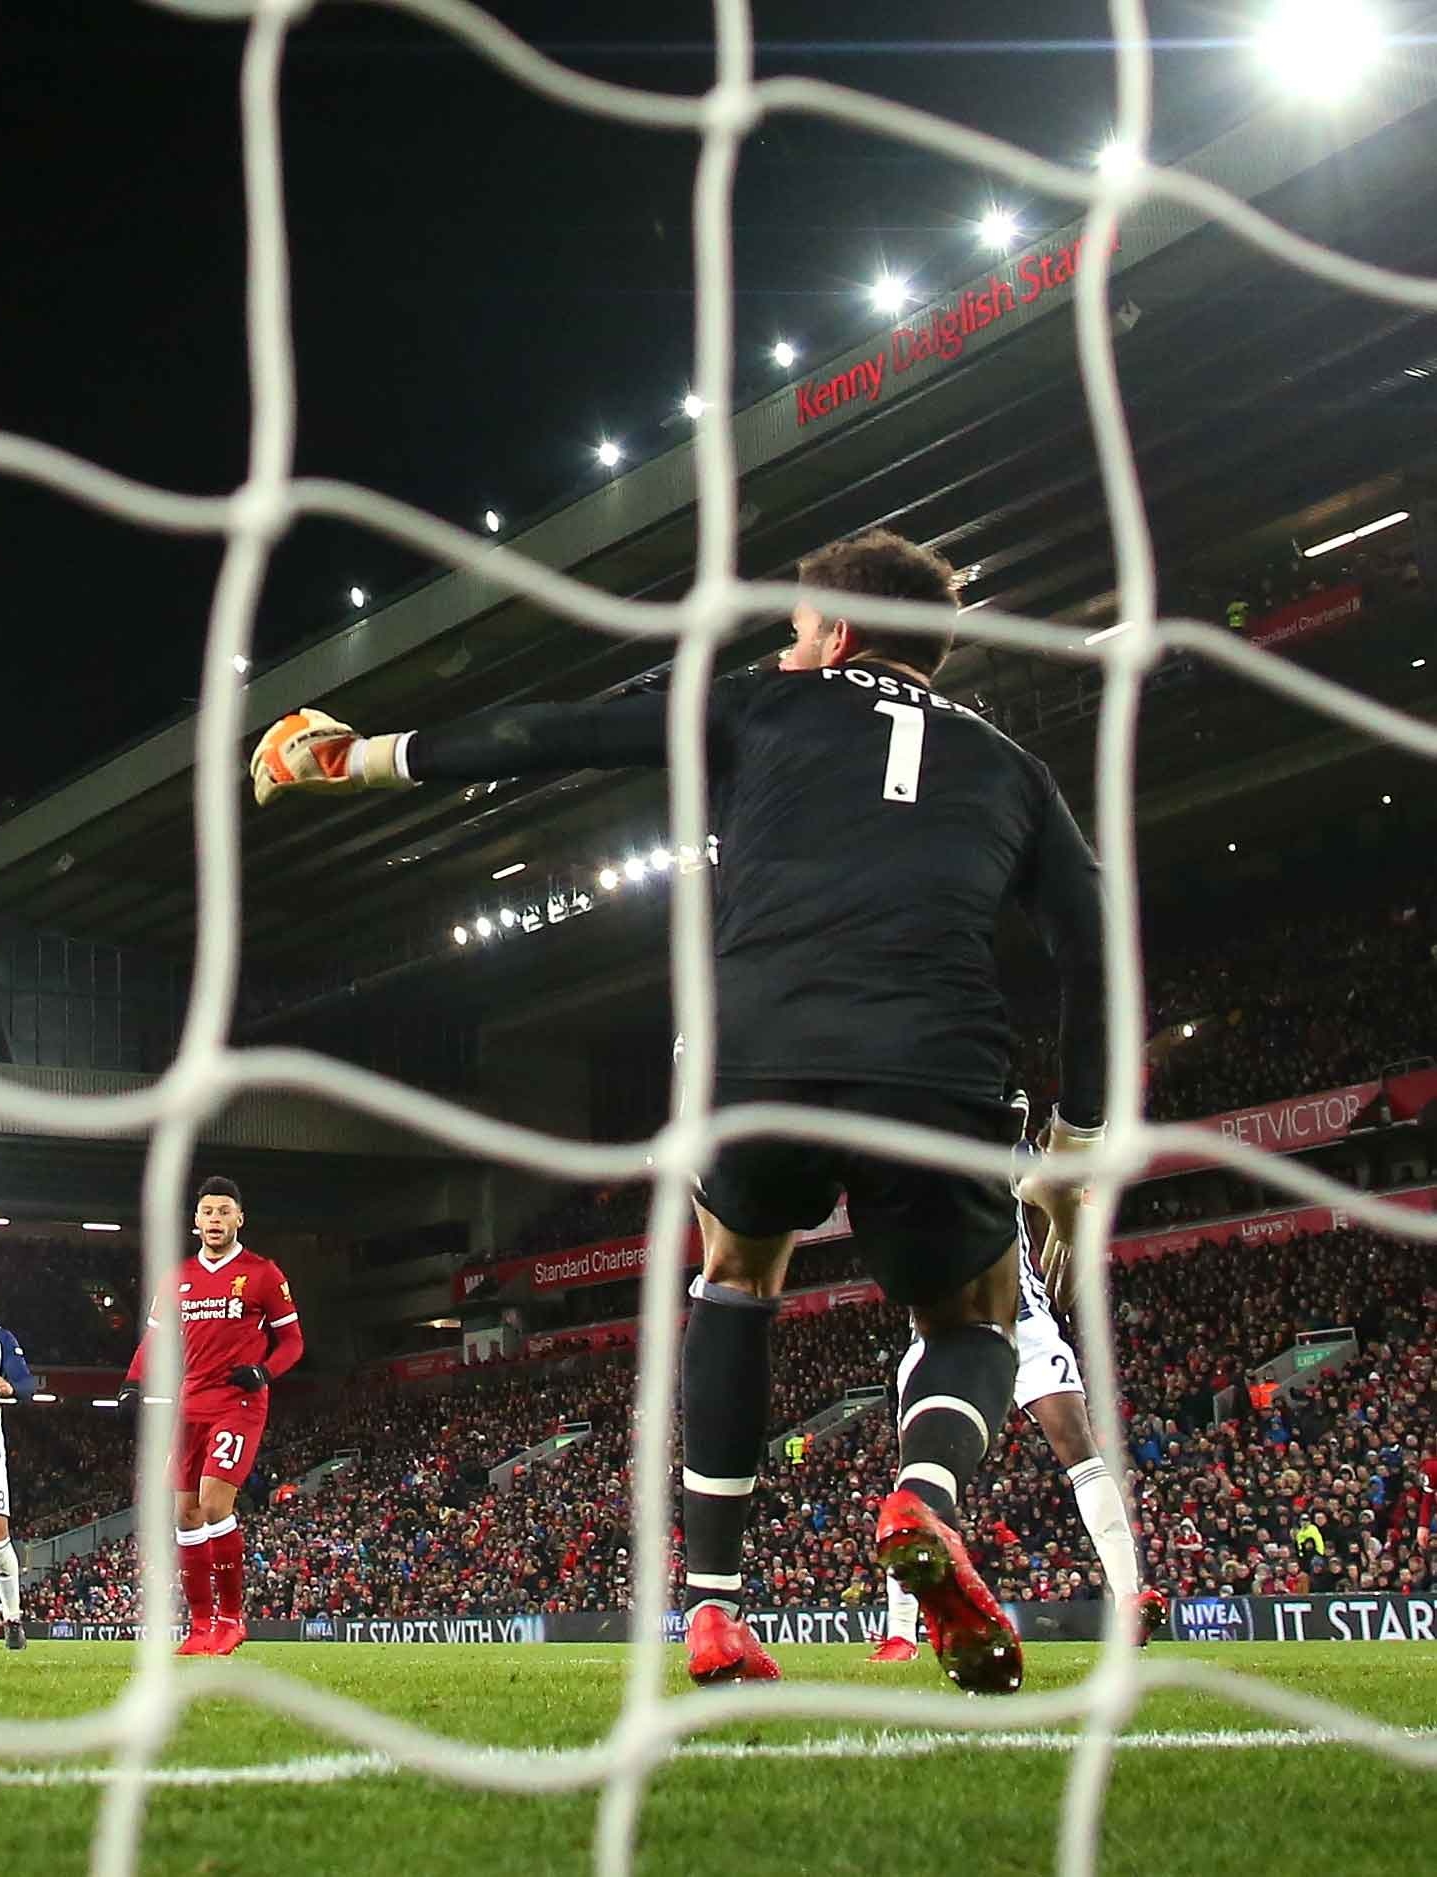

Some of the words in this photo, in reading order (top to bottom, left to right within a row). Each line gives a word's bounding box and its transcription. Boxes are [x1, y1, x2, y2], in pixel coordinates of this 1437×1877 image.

[795, 351, 886, 426] Kenny
[890, 275, 1016, 374] Dalglish
[1017, 224, 1122, 303] Sta
[821, 668, 982, 716] FOSTE
[873, 699, 925, 803] 1
[1221, 1095, 1361, 1147] BETVICTOR
[534, 1254, 590, 1284] Standard
[592, 1247, 659, 1273] Chartere
[181, 1297, 227, 1311] Standard
[181, 1308, 226, 1322] Chartered
[1051, 1354, 1075, 1384] 2
[211, 1430, 244, 1464] 21
[305, 1622, 333, 1637] NIVEA
[659, 1616, 688, 1632] IVEA
[746, 1611, 849, 1643] STARTS
[1181, 1604, 1243, 1625] NIVEA
[1273, 1602, 1313, 1642] IT
[1327, 1601, 1437, 1642] STAR
[346, 1622, 364, 1643] IT
[369, 1622, 439, 1643] STARTS
[444, 1620, 492, 1643] WITH
